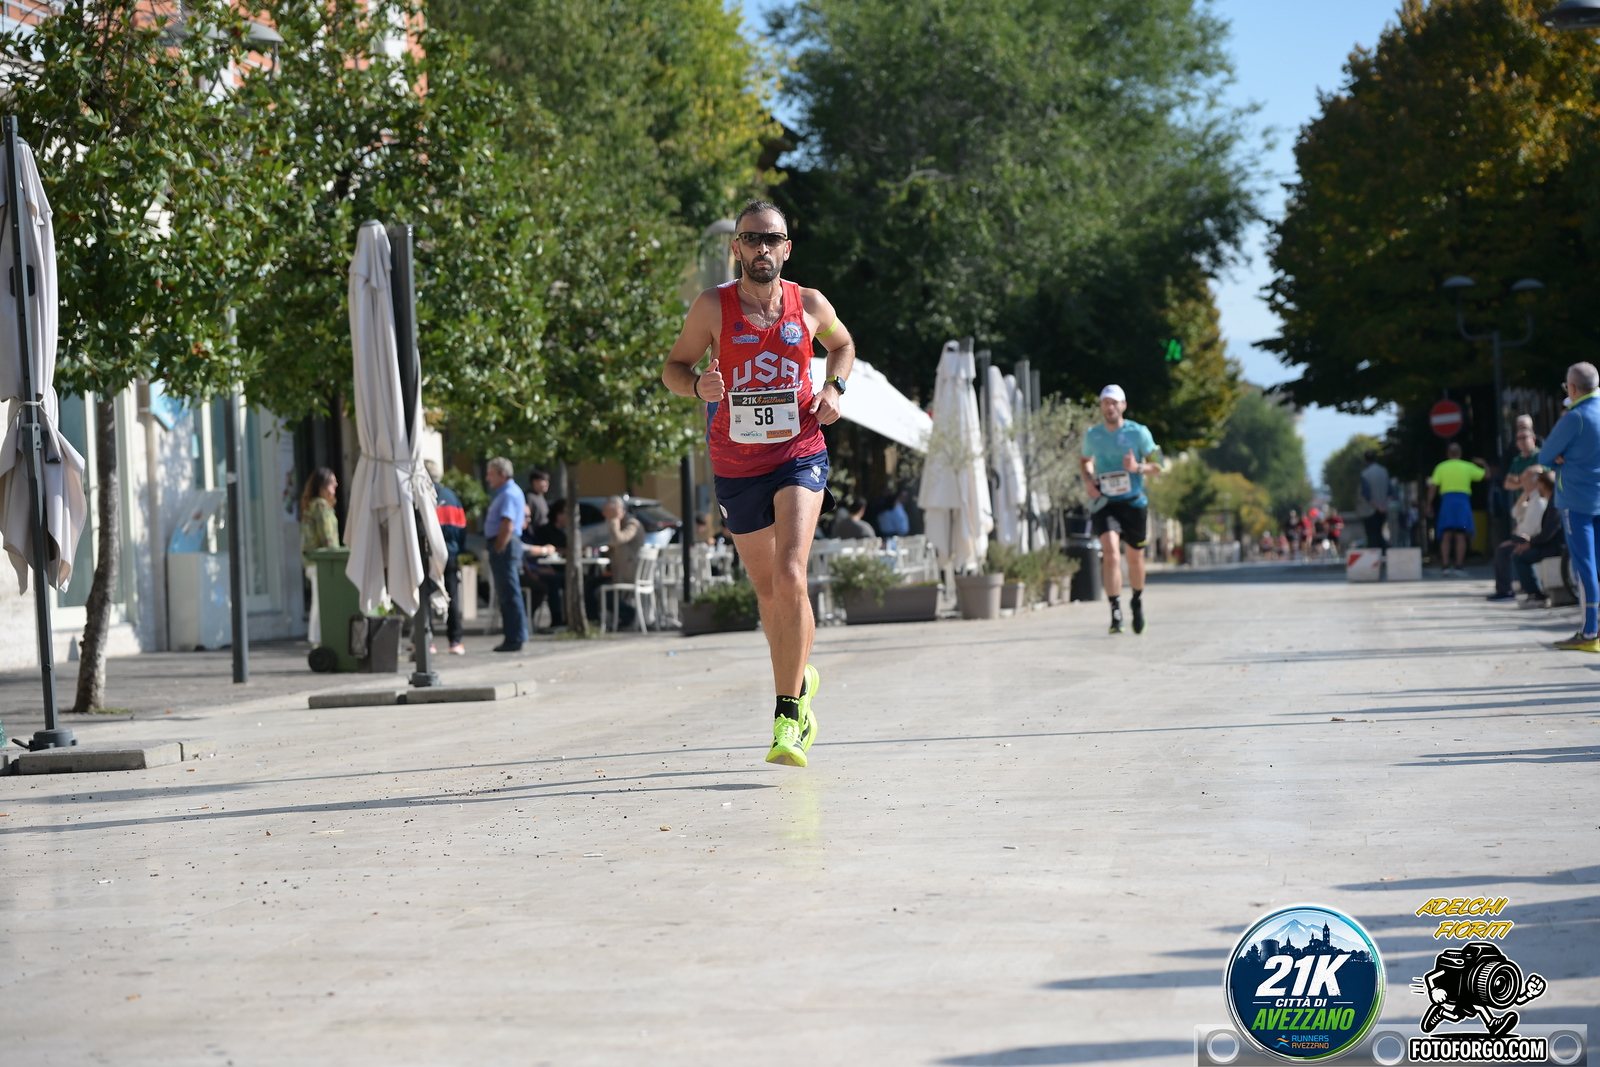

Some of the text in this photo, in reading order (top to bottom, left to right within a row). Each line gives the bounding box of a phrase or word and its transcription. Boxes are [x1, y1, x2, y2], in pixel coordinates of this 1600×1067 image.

[732, 350, 800, 388] USA
[742, 396, 757, 405] 21K
[754, 407, 774, 425] 58
